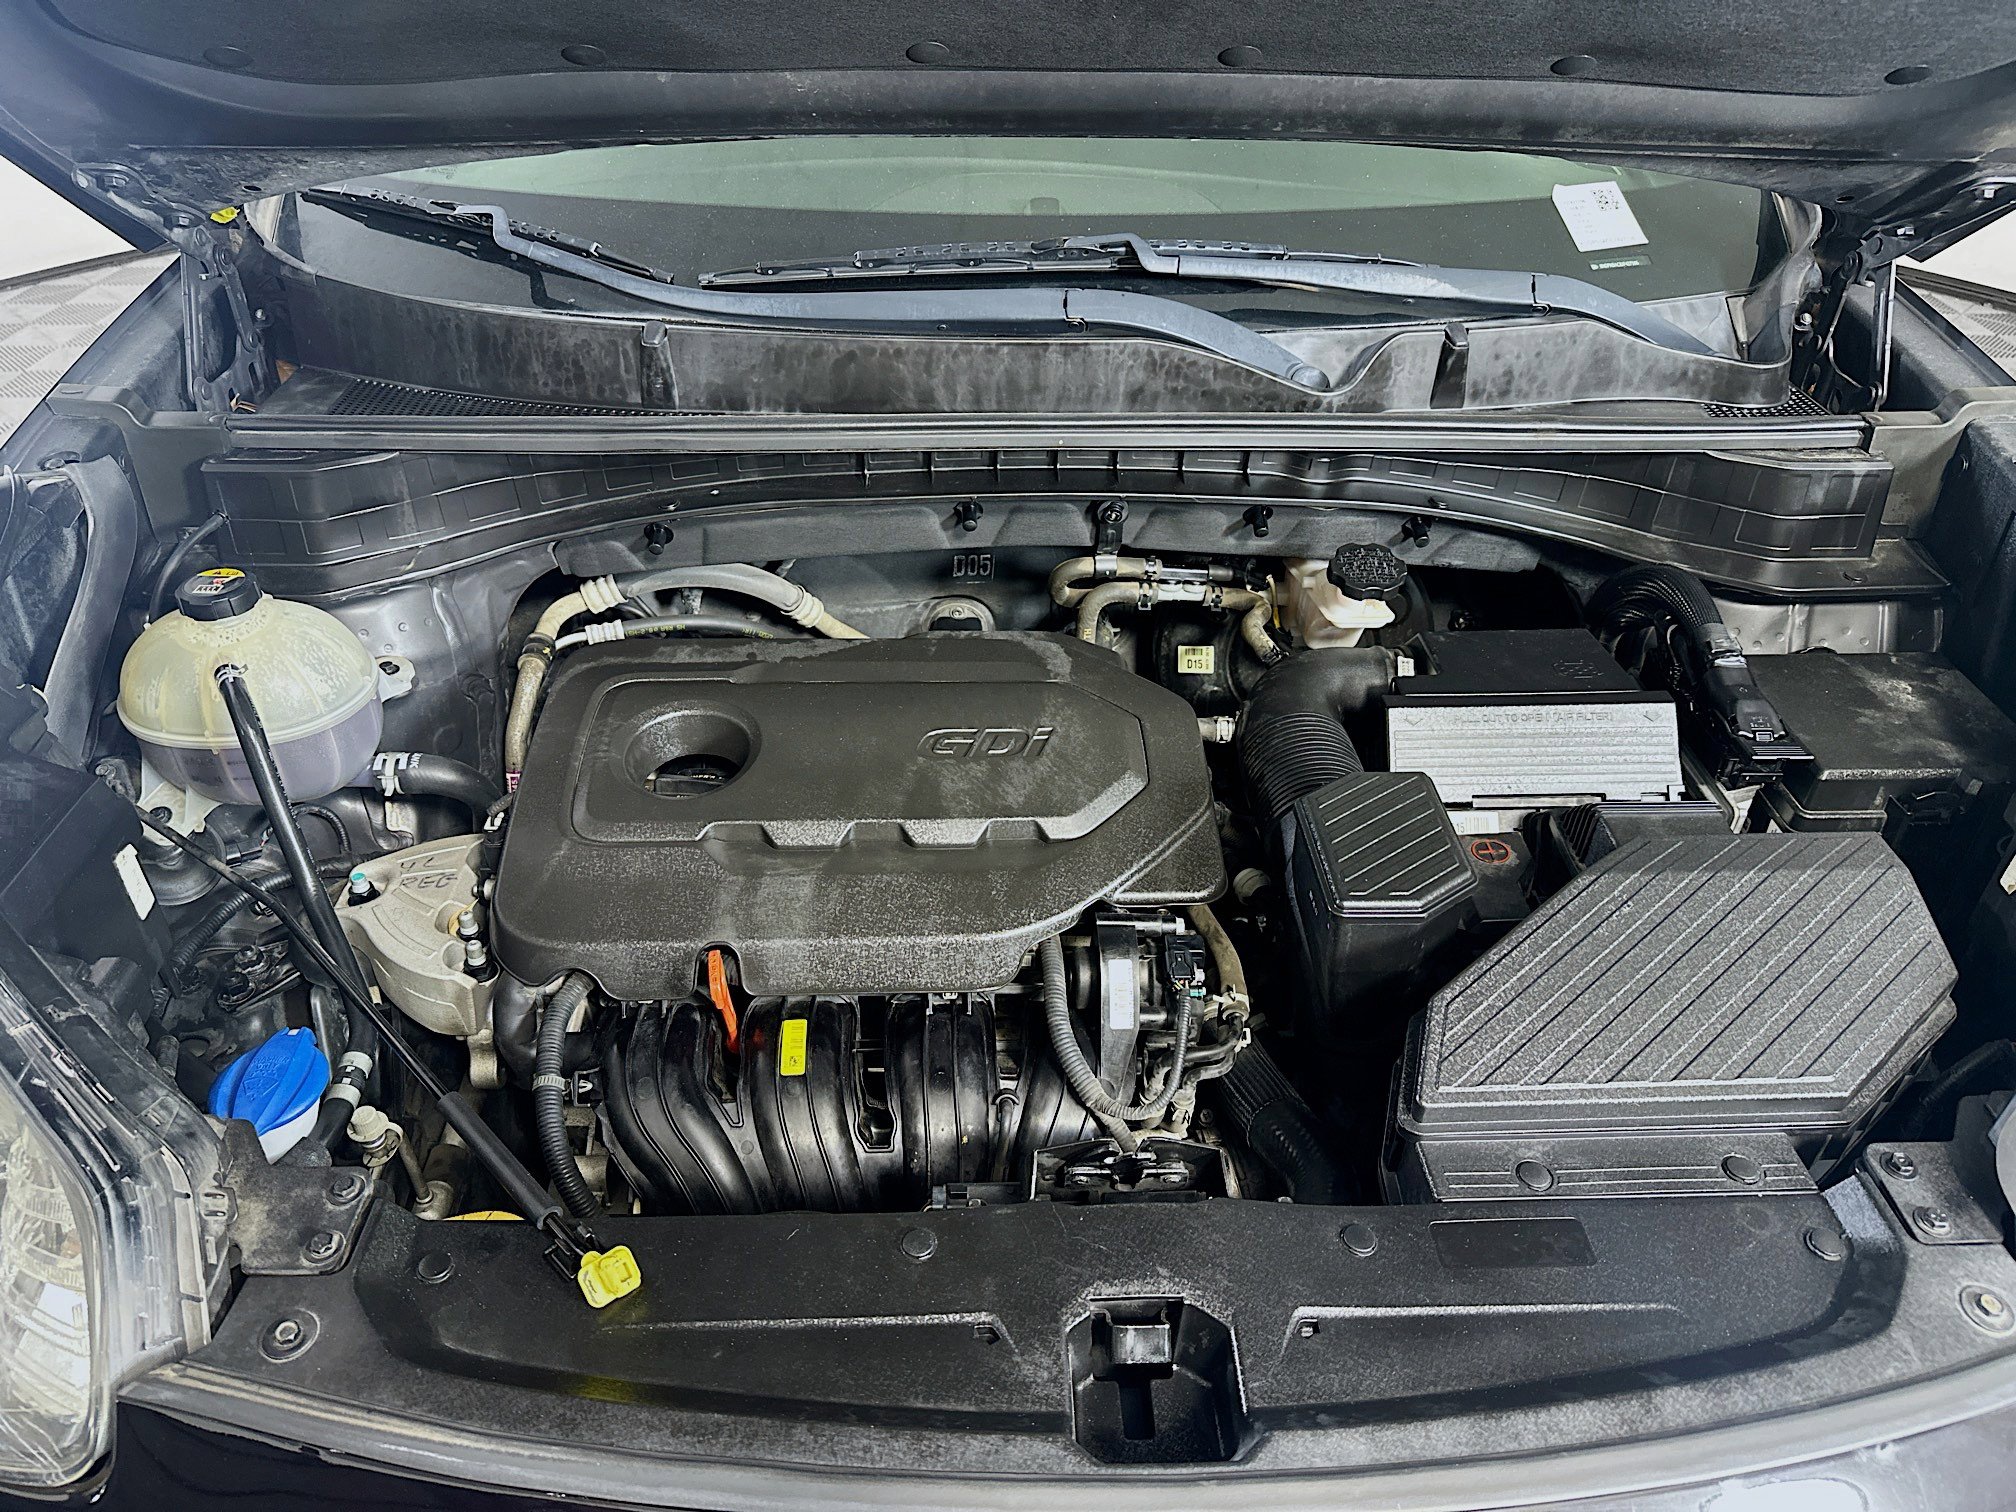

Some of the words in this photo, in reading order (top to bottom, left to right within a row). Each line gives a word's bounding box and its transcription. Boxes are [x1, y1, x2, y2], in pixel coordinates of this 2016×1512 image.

[952, 554, 991, 578] D05
[1187, 659, 1203, 669] D15
[1504, 713, 1519, 722] TO
[916, 727, 1054, 758] GDi
